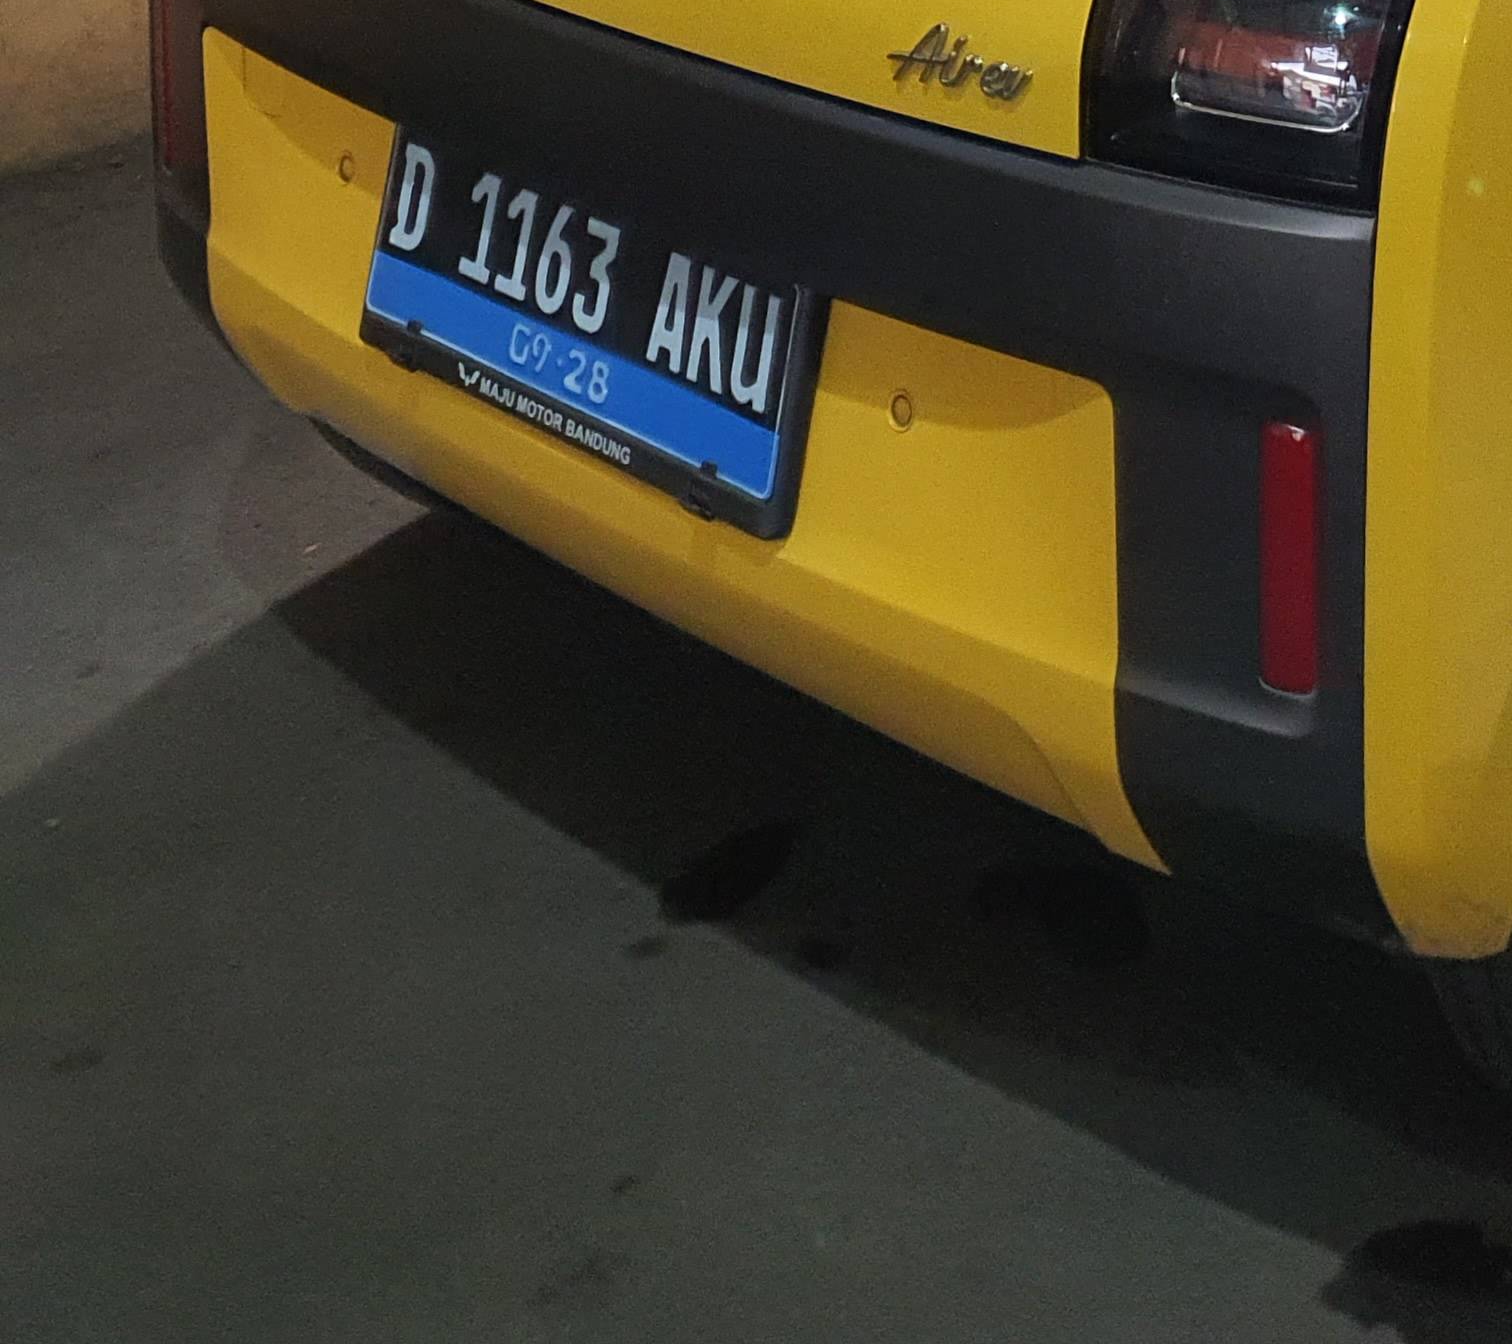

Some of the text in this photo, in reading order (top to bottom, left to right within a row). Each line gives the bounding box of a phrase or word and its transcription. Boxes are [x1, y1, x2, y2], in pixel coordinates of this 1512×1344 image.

[388, 143, 783, 413] D 1163 AKU
[479, 376, 632, 465] MAJU MOTOR BANDUNG
